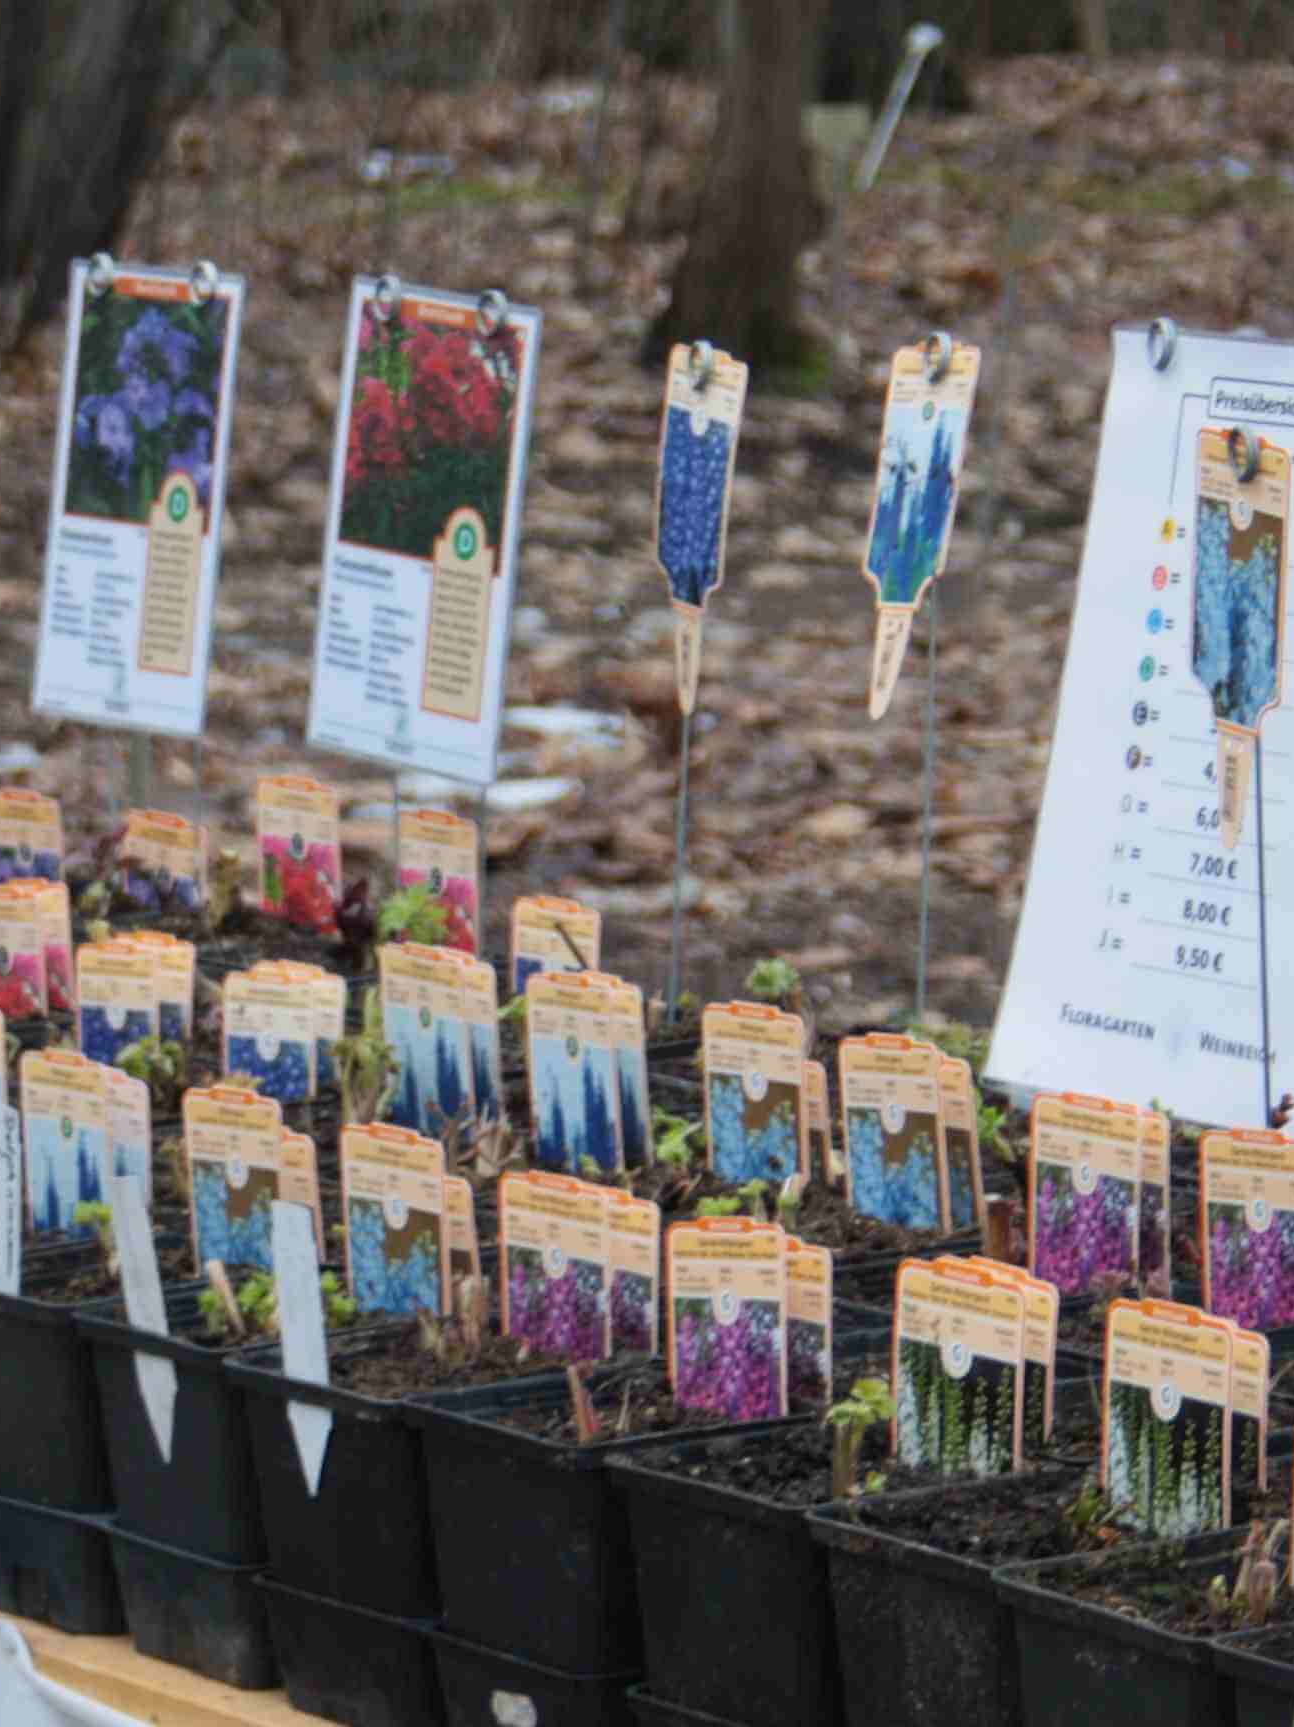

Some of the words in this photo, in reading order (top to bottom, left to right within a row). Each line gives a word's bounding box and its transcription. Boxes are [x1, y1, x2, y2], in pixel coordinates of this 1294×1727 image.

[1189, 852, 1224, 877] 7,00
[1226, 858, 1238, 880] €
[1182, 898, 1217, 924] 8,00
[1220, 905, 1233, 927] €
[1175, 943, 1211, 970] 9,50
[1212, 951, 1225, 974] €
